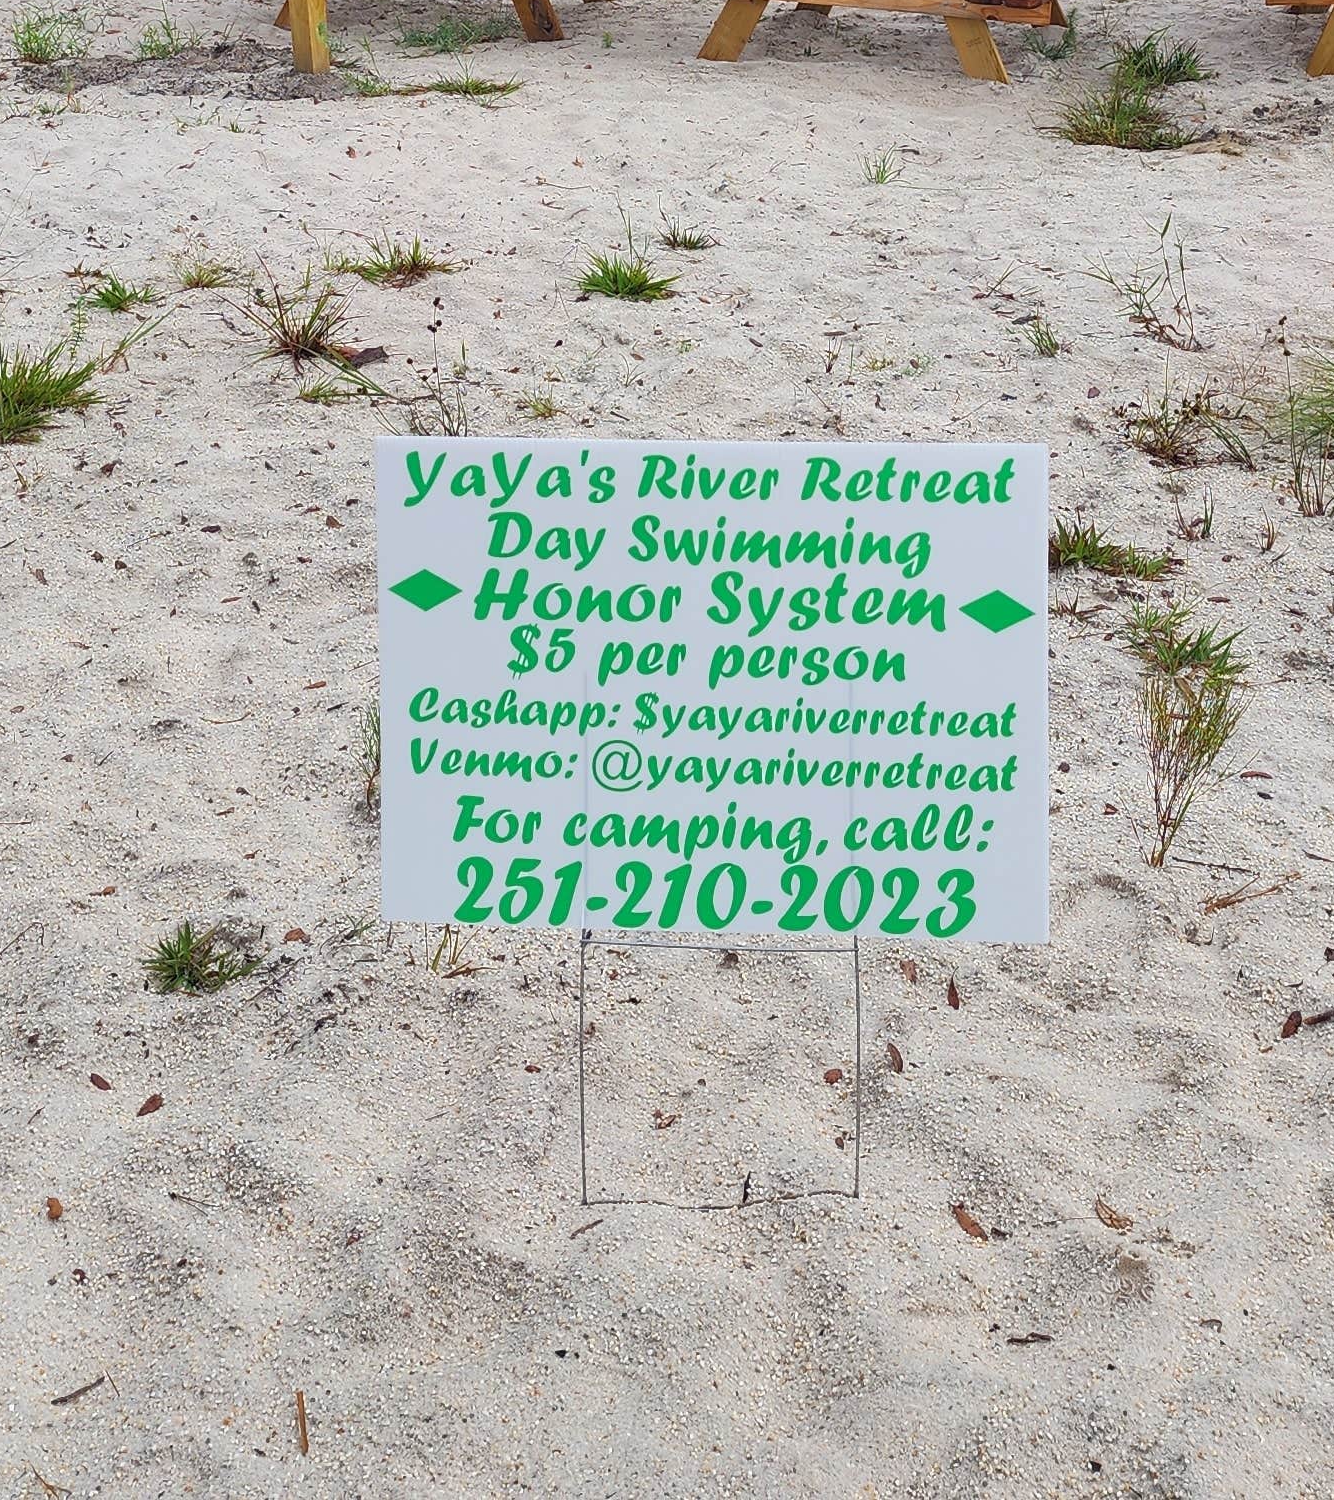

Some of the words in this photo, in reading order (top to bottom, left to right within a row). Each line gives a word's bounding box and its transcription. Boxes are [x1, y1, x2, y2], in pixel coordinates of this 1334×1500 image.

[404, 450, 616, 508] YaYa's
[637, 453, 780, 501] River
[800, 455, 1015, 505] Retreat
[487, 510, 606, 571] Day
[628, 513, 932, 580] Swimming
[473, 567, 682, 624] Honor
[706, 569, 948, 638] System
[506, 622, 576, 682] $5
[597, 641, 687, 686] per
[708, 644, 908, 690] person
[408, 686, 621, 736] Cashapp:
[634, 691, 1018, 739] $yayariverretreat
[409, 738, 579, 783] Venmo:
[591, 738, 1018, 794] @yayariverretreat
[452, 794, 543, 845] For
[562, 801, 829, 864] camping,
[842, 803, 995, 854] call:
[453, 854, 978, 939] 251-210-2023
